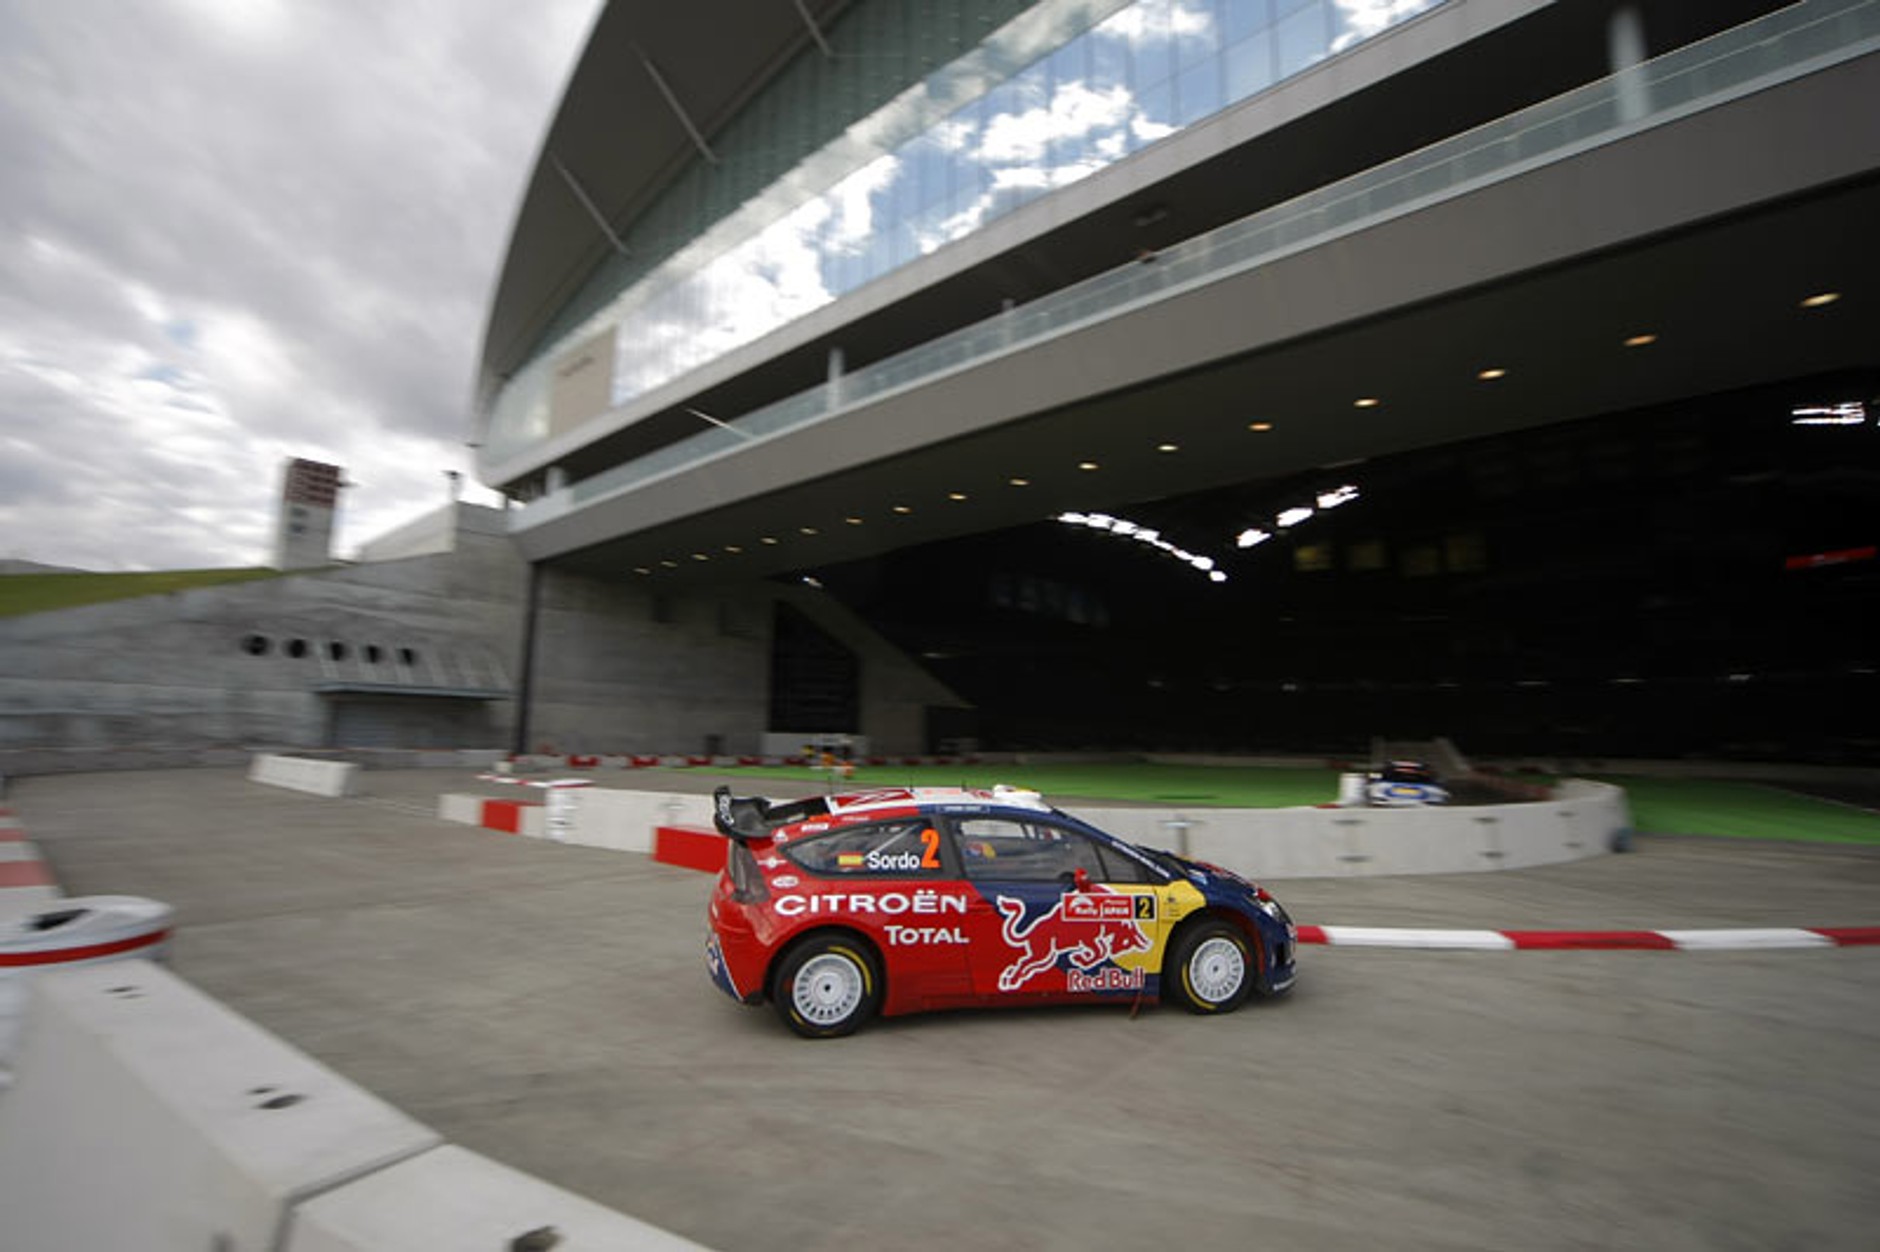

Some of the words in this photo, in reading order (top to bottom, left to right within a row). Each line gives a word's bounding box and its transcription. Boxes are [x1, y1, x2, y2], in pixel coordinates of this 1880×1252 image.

[920, 828, 941, 869] 2
[867, 852, 920, 869] Sordo
[774, 890, 968, 915] CITROËN
[1139, 897, 1151, 919] 2
[884, 925, 969, 944] TOTAL
[1067, 967, 1106, 992] Red
[1109, 965, 1145, 990] Bull
